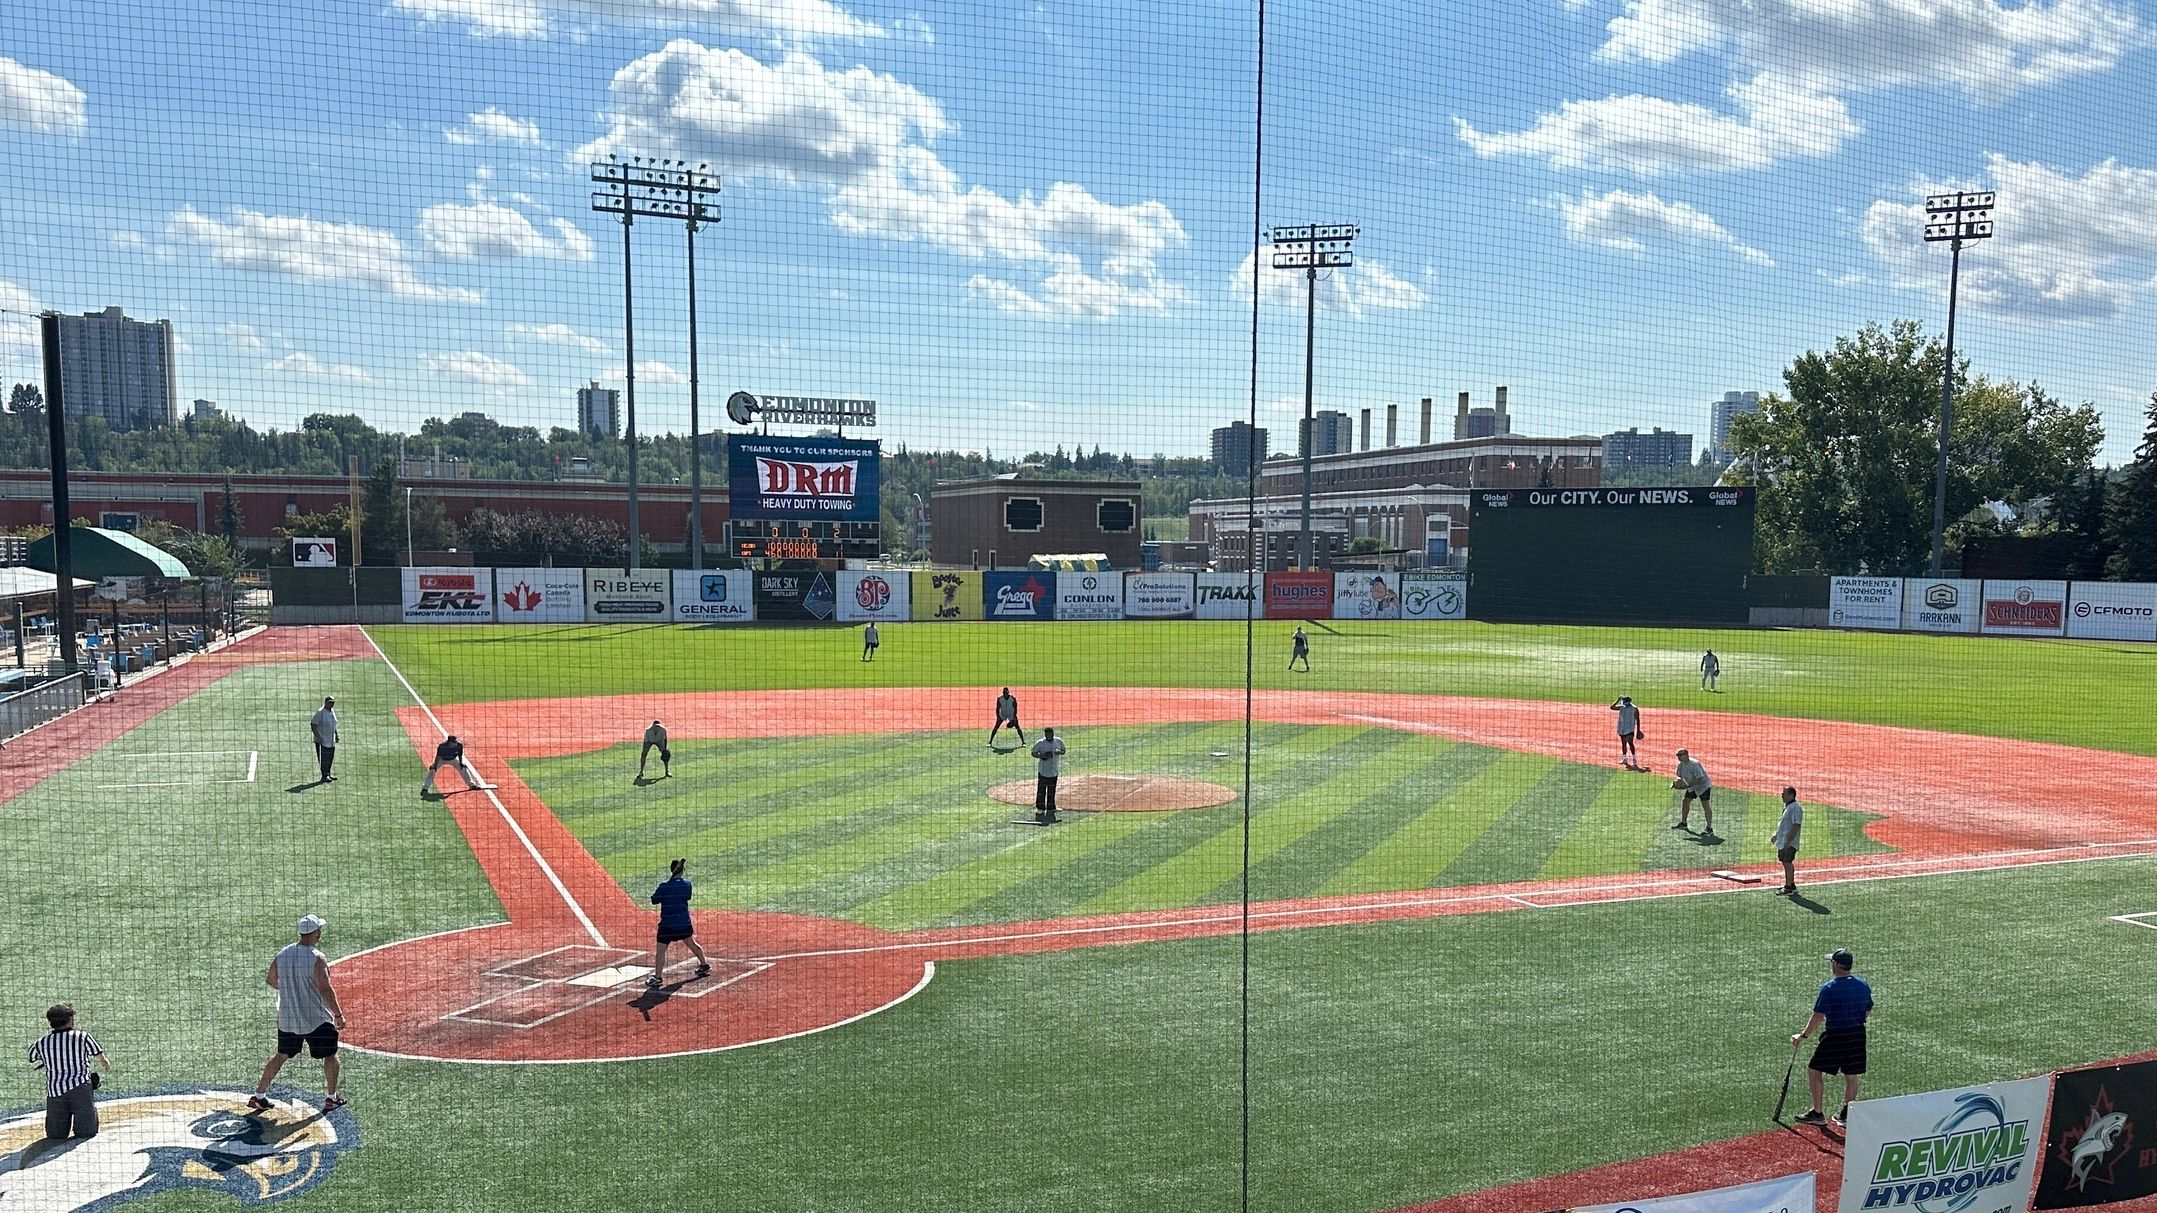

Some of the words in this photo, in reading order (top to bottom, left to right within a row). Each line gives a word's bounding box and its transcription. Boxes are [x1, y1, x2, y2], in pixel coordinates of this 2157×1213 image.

[761, 395, 877, 415] EDMONTON
[761, 410, 877, 427] RIVERHAWKS
[740, 444, 771, 453] THANK
[773, 446, 793, 454] YOU
[794, 446, 806, 455] TO
[807, 447, 826, 455] OUR
[828, 448, 874, 457] SPONSORS
[1482, 493, 1509, 501] Global
[1529, 491, 1557, 505] Our
[1561, 490, 1602, 505] CITY.
[1606, 491, 1636, 504] Our
[1639, 489, 1694, 504] NEWS.
[1709, 491, 1738, 500] Global
[763, 498, 792, 509] HEAVY
[794, 499, 817, 509] DUTY
[819, 500, 853, 510] TOWING
[593, 580, 664, 593] RIBEYE
[761, 577, 782, 589] DARK
[783, 577, 799, 589] SKY
[1835, 579, 1890, 588] APARTMENTS
[1891, 580, 1898, 588] &
[996, 584, 1035, 608] Gregg
[1198, 584, 1261, 605] TRAXX
[1271, 582, 1328, 601] hughes
[1839, 587, 1893, 596] TOWNHOMES
[1064, 594, 1115, 603] CONLON
[679, 605, 747, 614] GENERAL
[1988, 603, 2058, 625] SCHNEIDERS
[2093, 606, 2153, 616] CFMOTO
[1919, 612, 1962, 624] ARRKANN
[1872, 1120, 2030, 1184] REVIVAL
[1861, 1159, 2024, 1211] HYDROVAC
